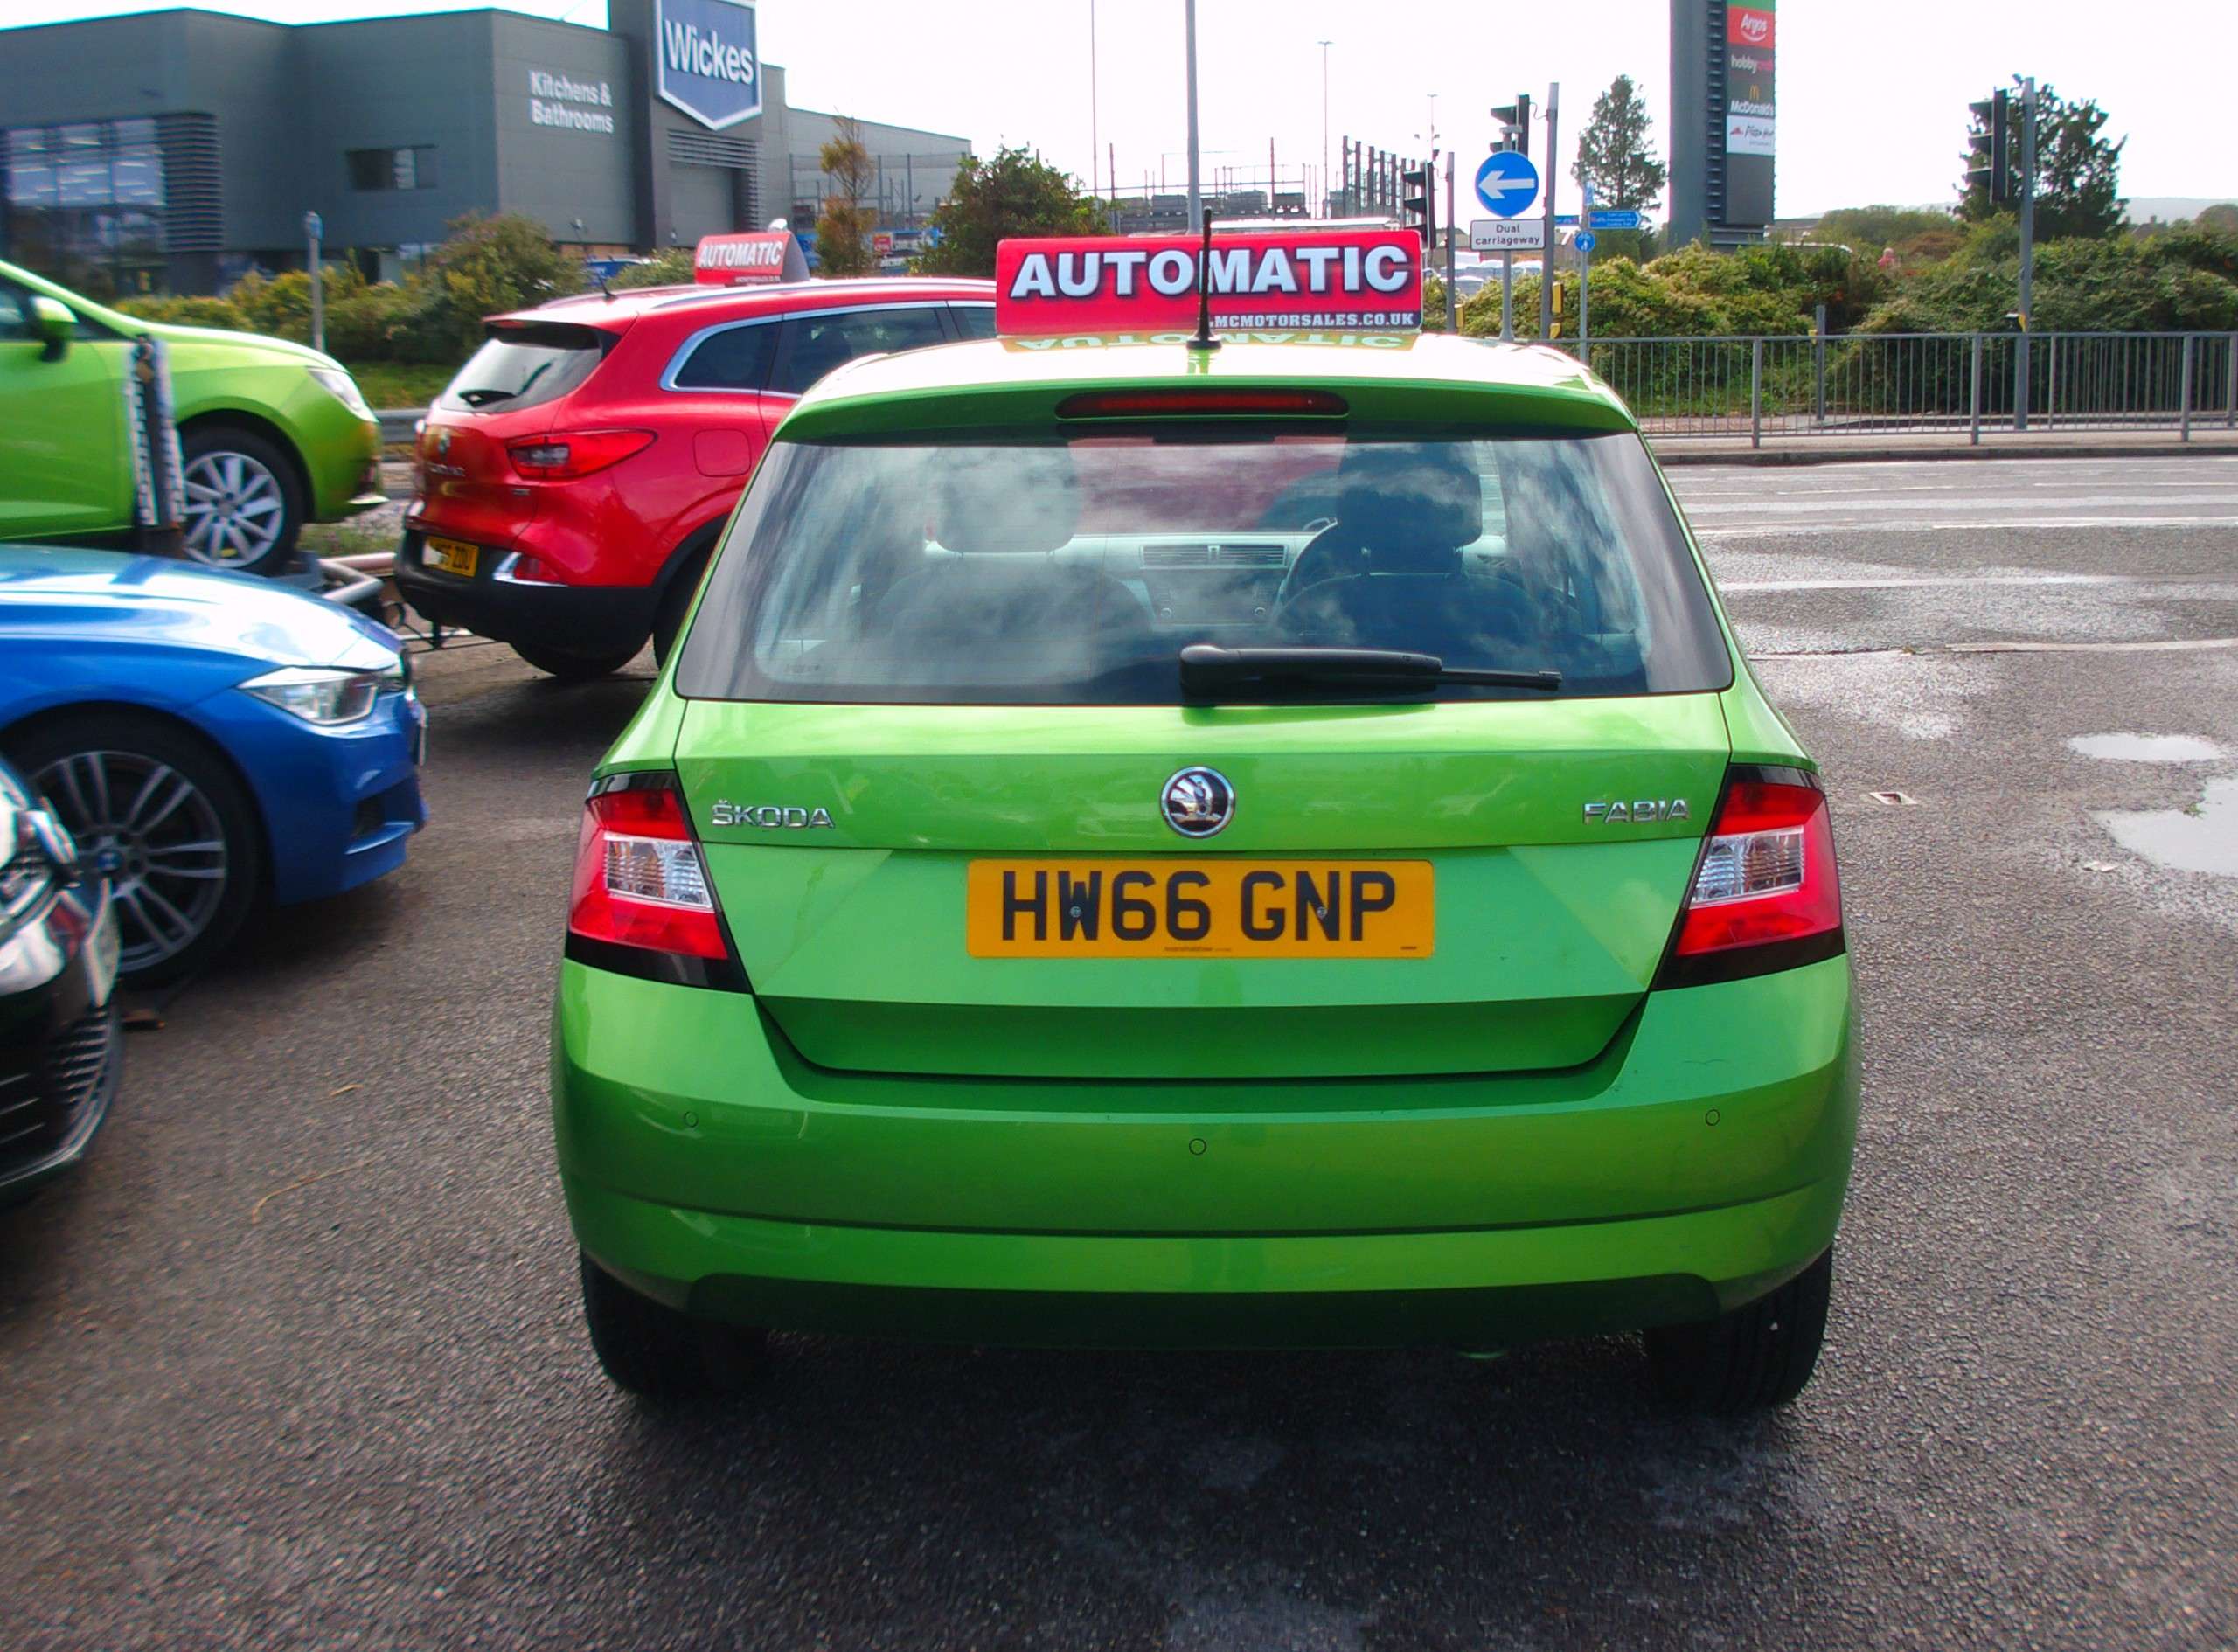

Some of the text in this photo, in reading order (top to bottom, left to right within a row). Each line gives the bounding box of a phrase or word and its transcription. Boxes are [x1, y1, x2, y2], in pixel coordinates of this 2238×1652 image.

[1741, 13, 1768, 34] Argos
[665, 19, 754, 86] Wickes
[529, 70, 613, 107] Kitchens &
[531, 99, 615, 134] Bathrooms
[1475, 235, 1541, 246] carriageway
[1496, 224, 1520, 233] Dual
[699, 241, 783, 268] AUTOMATIC
[1011, 246, 1410, 298] AUTOMATIC
[1583, 798, 1690, 825] FABIA
[1003, 870, 1396, 941] HW66 GNP
